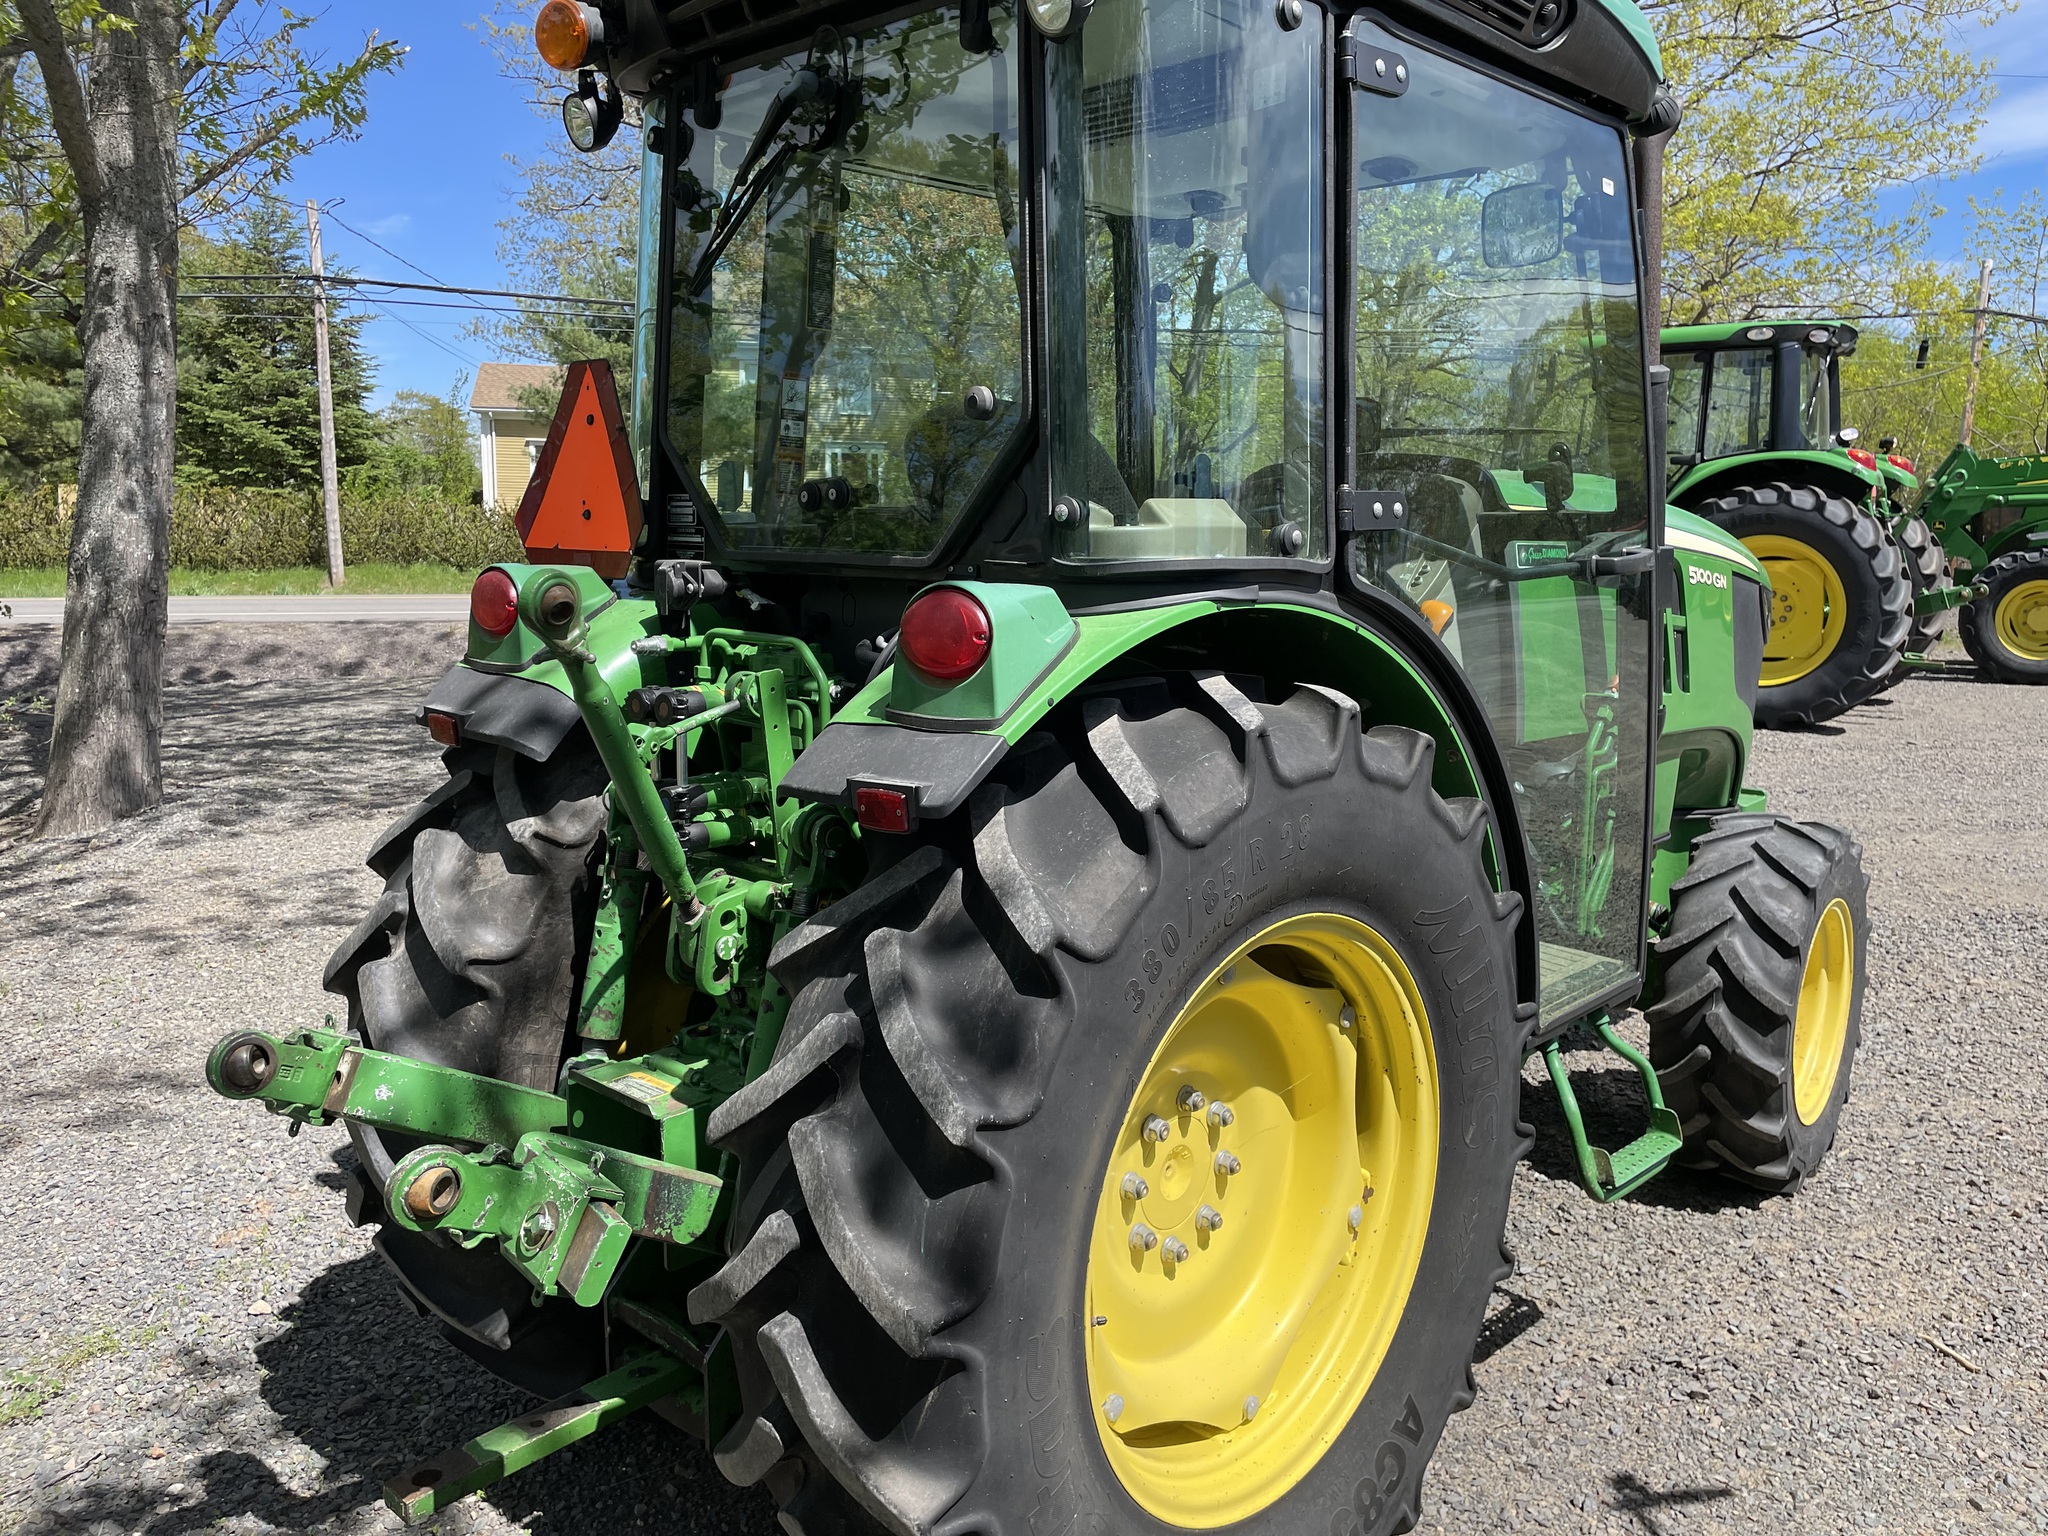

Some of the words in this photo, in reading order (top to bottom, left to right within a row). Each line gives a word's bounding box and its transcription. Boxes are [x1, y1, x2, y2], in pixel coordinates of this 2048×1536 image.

[1688, 565, 1713, 585] 5100
[1713, 572, 1727, 589] GN
[1249, 837, 1267, 876] R
[1280, 814, 1313, 861] 28
